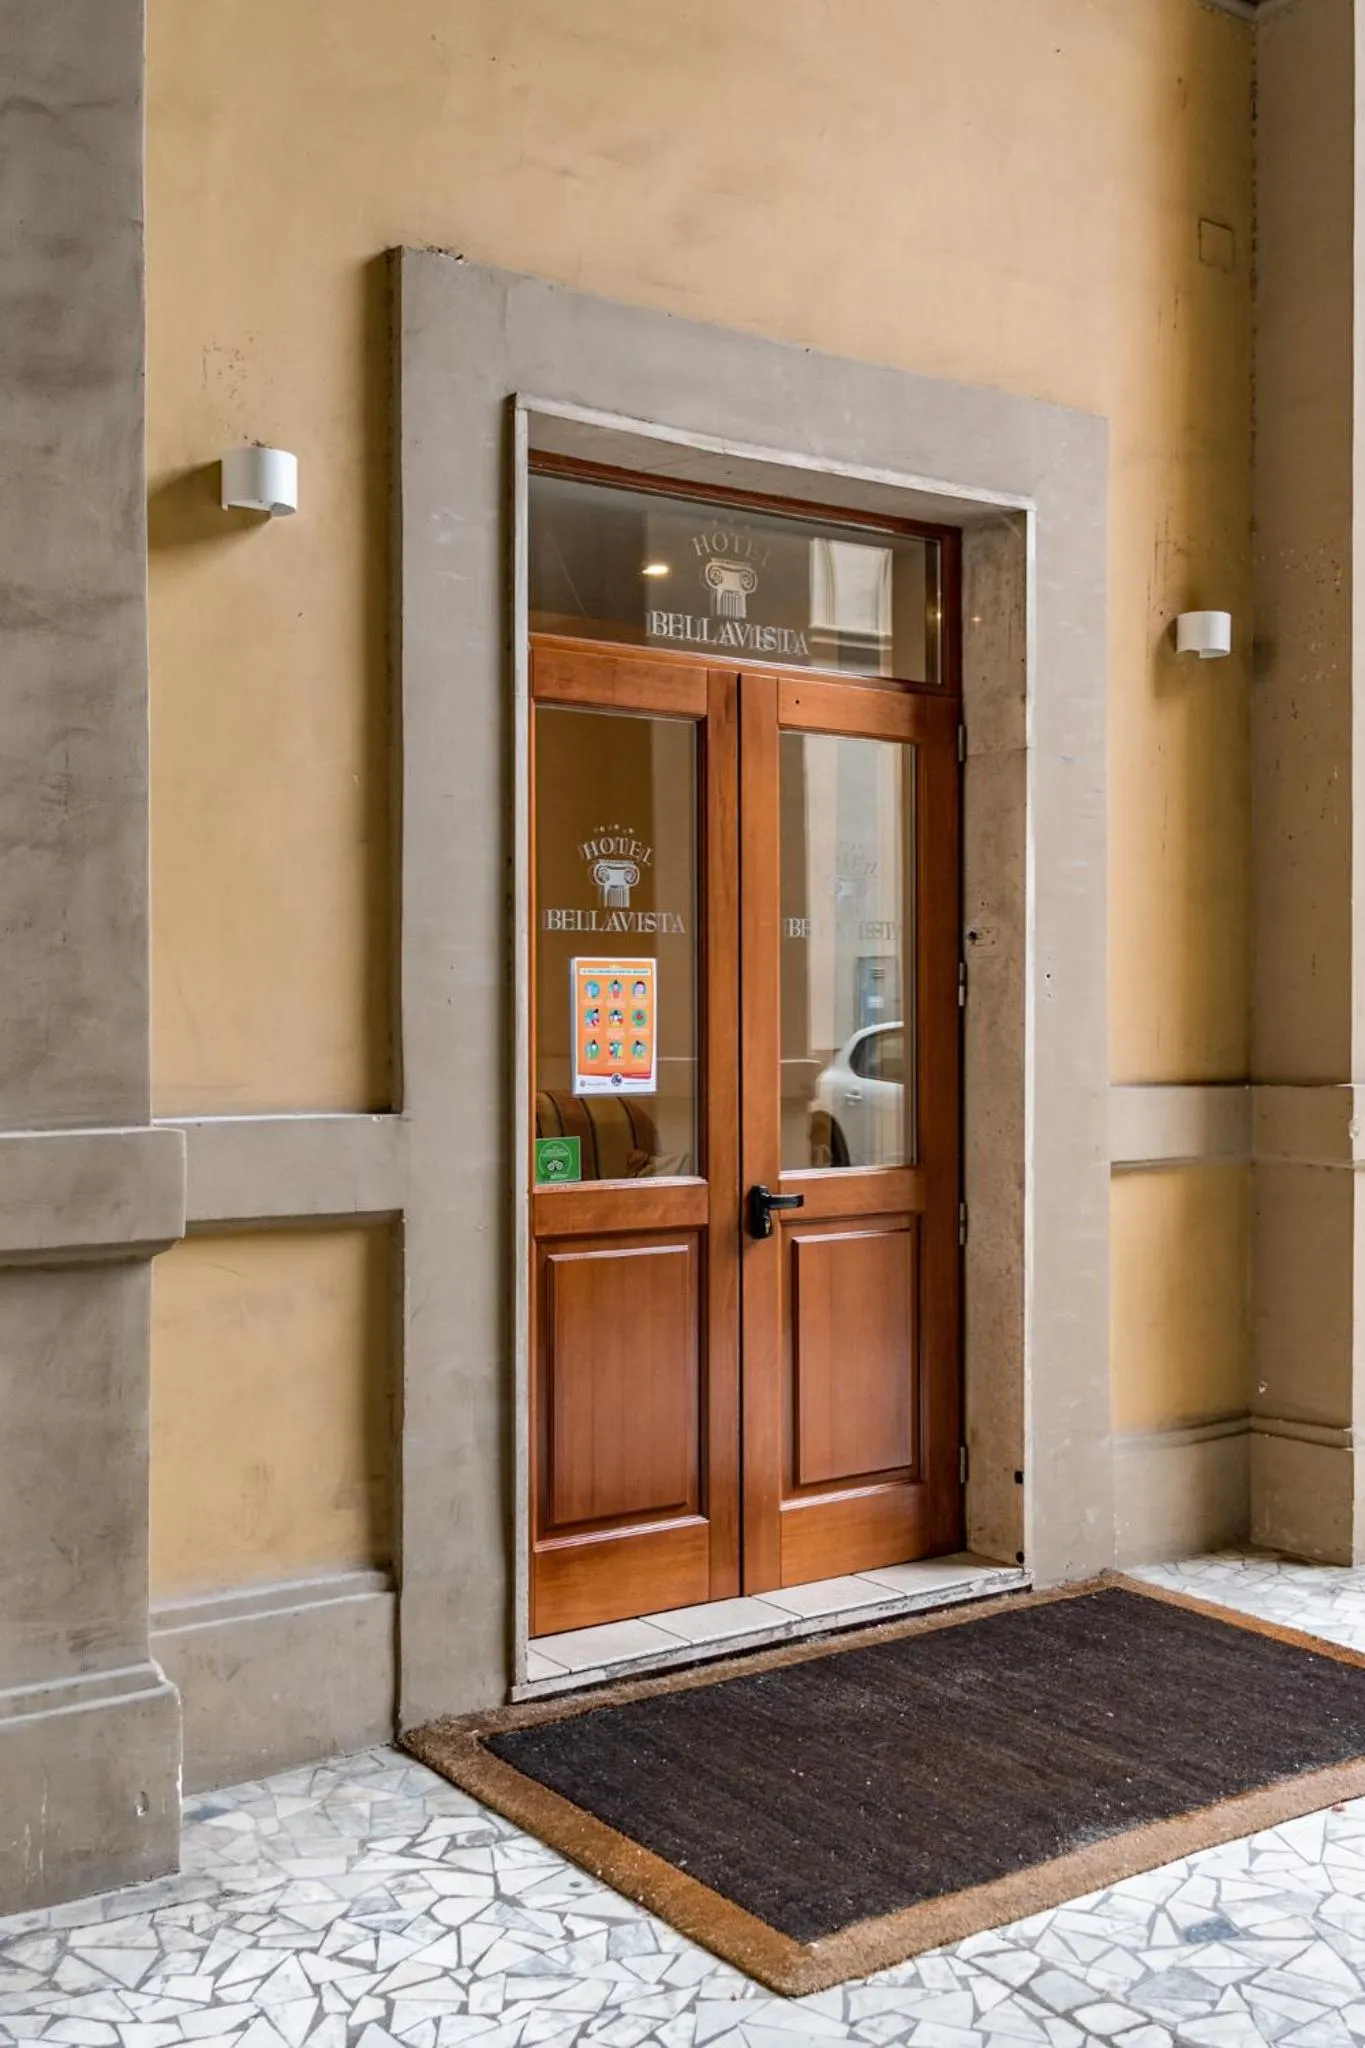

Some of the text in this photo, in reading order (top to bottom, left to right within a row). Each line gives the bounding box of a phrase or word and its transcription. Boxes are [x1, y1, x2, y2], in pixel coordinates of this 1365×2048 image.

[692, 531, 771, 571] HOTEL
[650, 611, 809, 655] BELLAVISTA
[582, 836, 653, 866] HOTEL
[547, 908, 686, 934] BELLAVISTA
